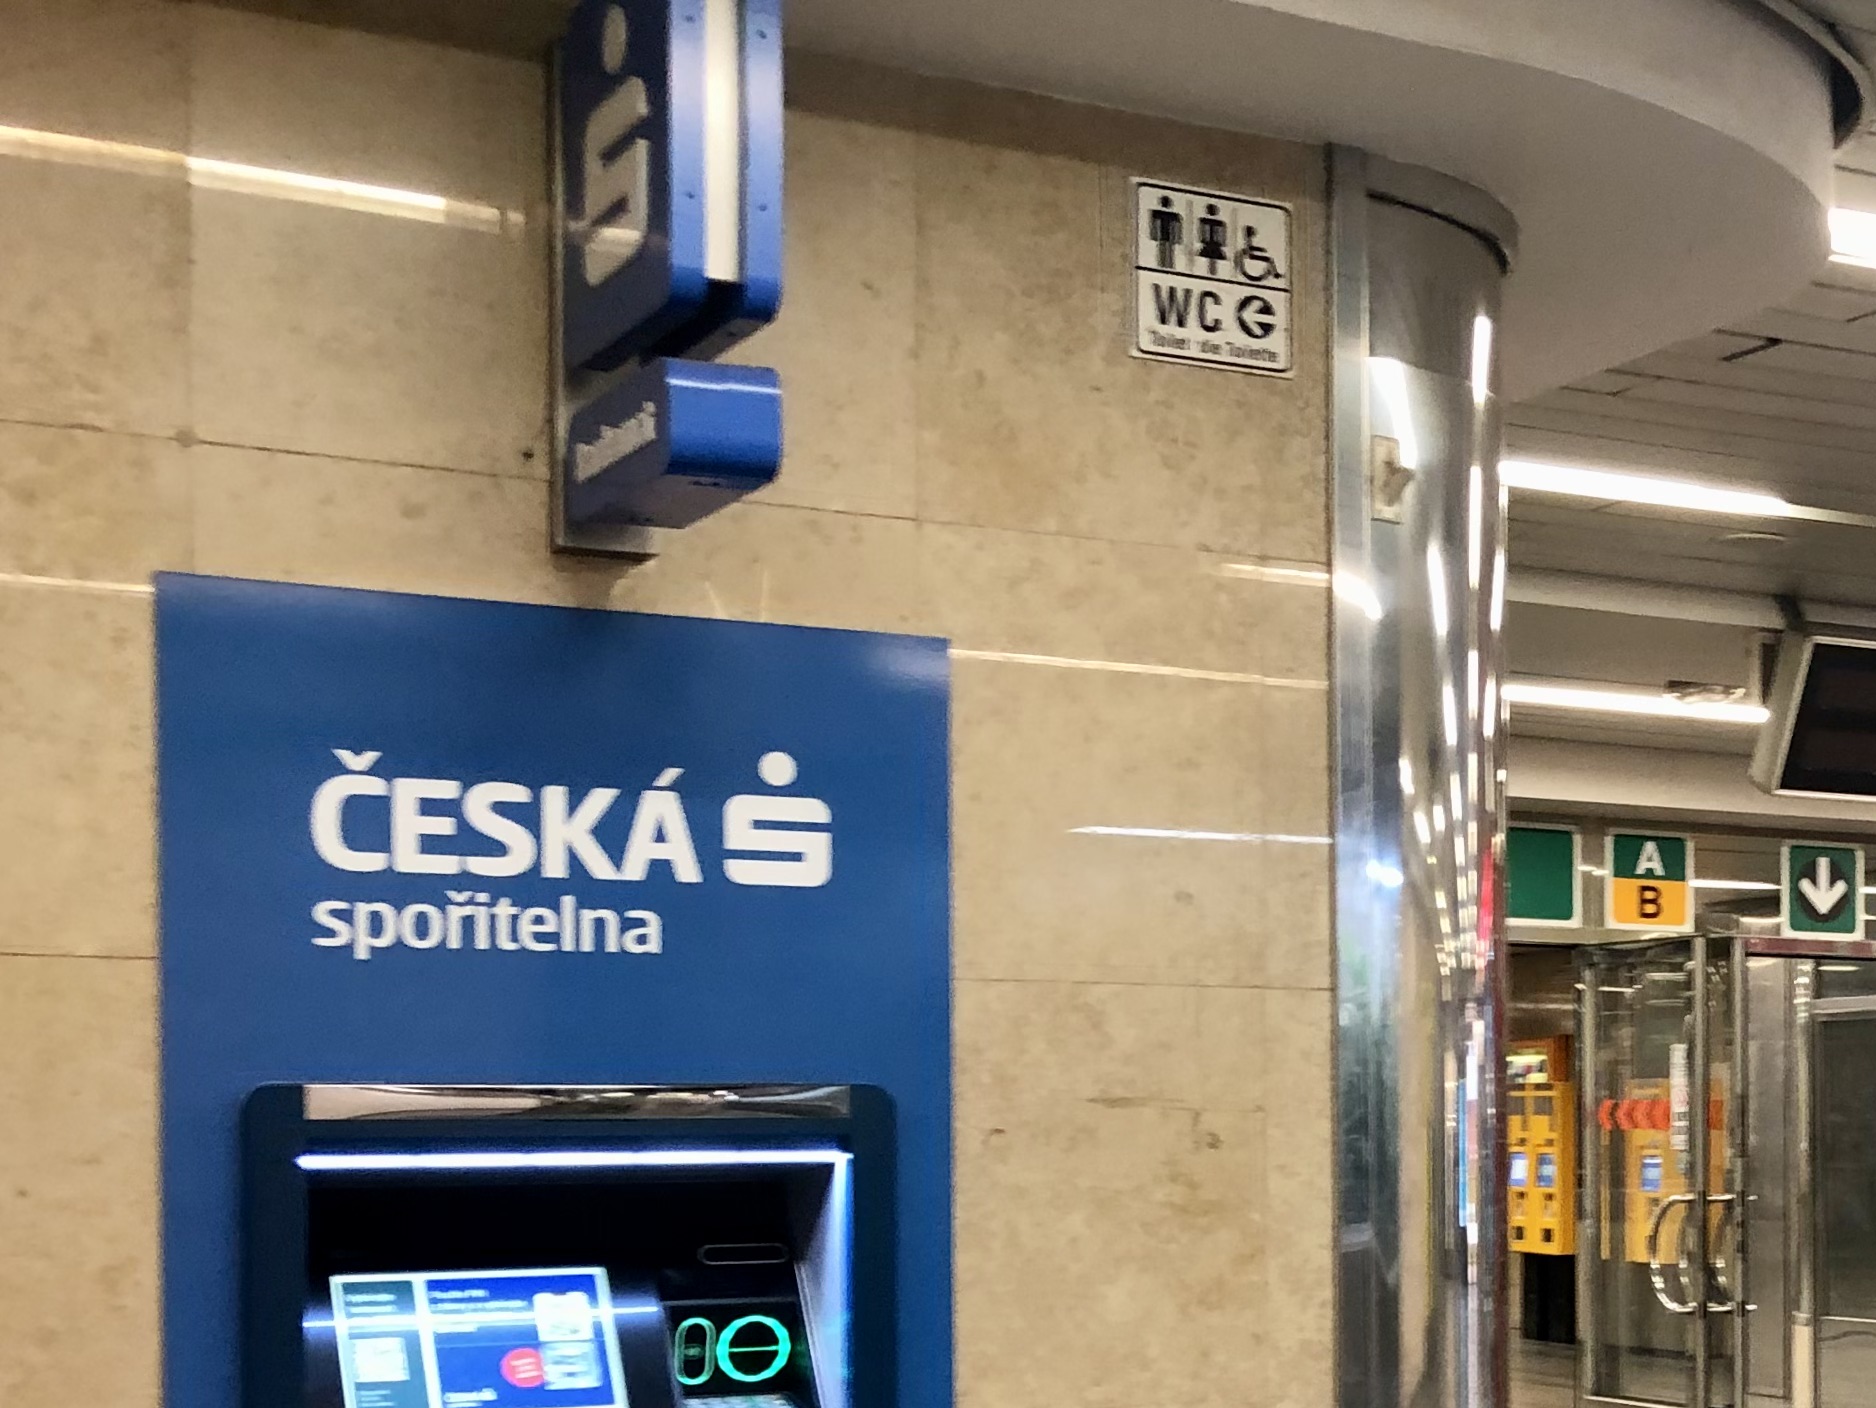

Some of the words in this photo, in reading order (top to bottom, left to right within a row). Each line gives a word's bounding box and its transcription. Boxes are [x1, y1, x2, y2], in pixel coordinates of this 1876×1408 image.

[1152, 283, 1224, 333] WC
[309, 748, 705, 883] ČESKÁ
[1633, 841, 1666, 876] A
[310, 890, 663, 961] spořitelna
[1637, 885, 1663, 919] B
